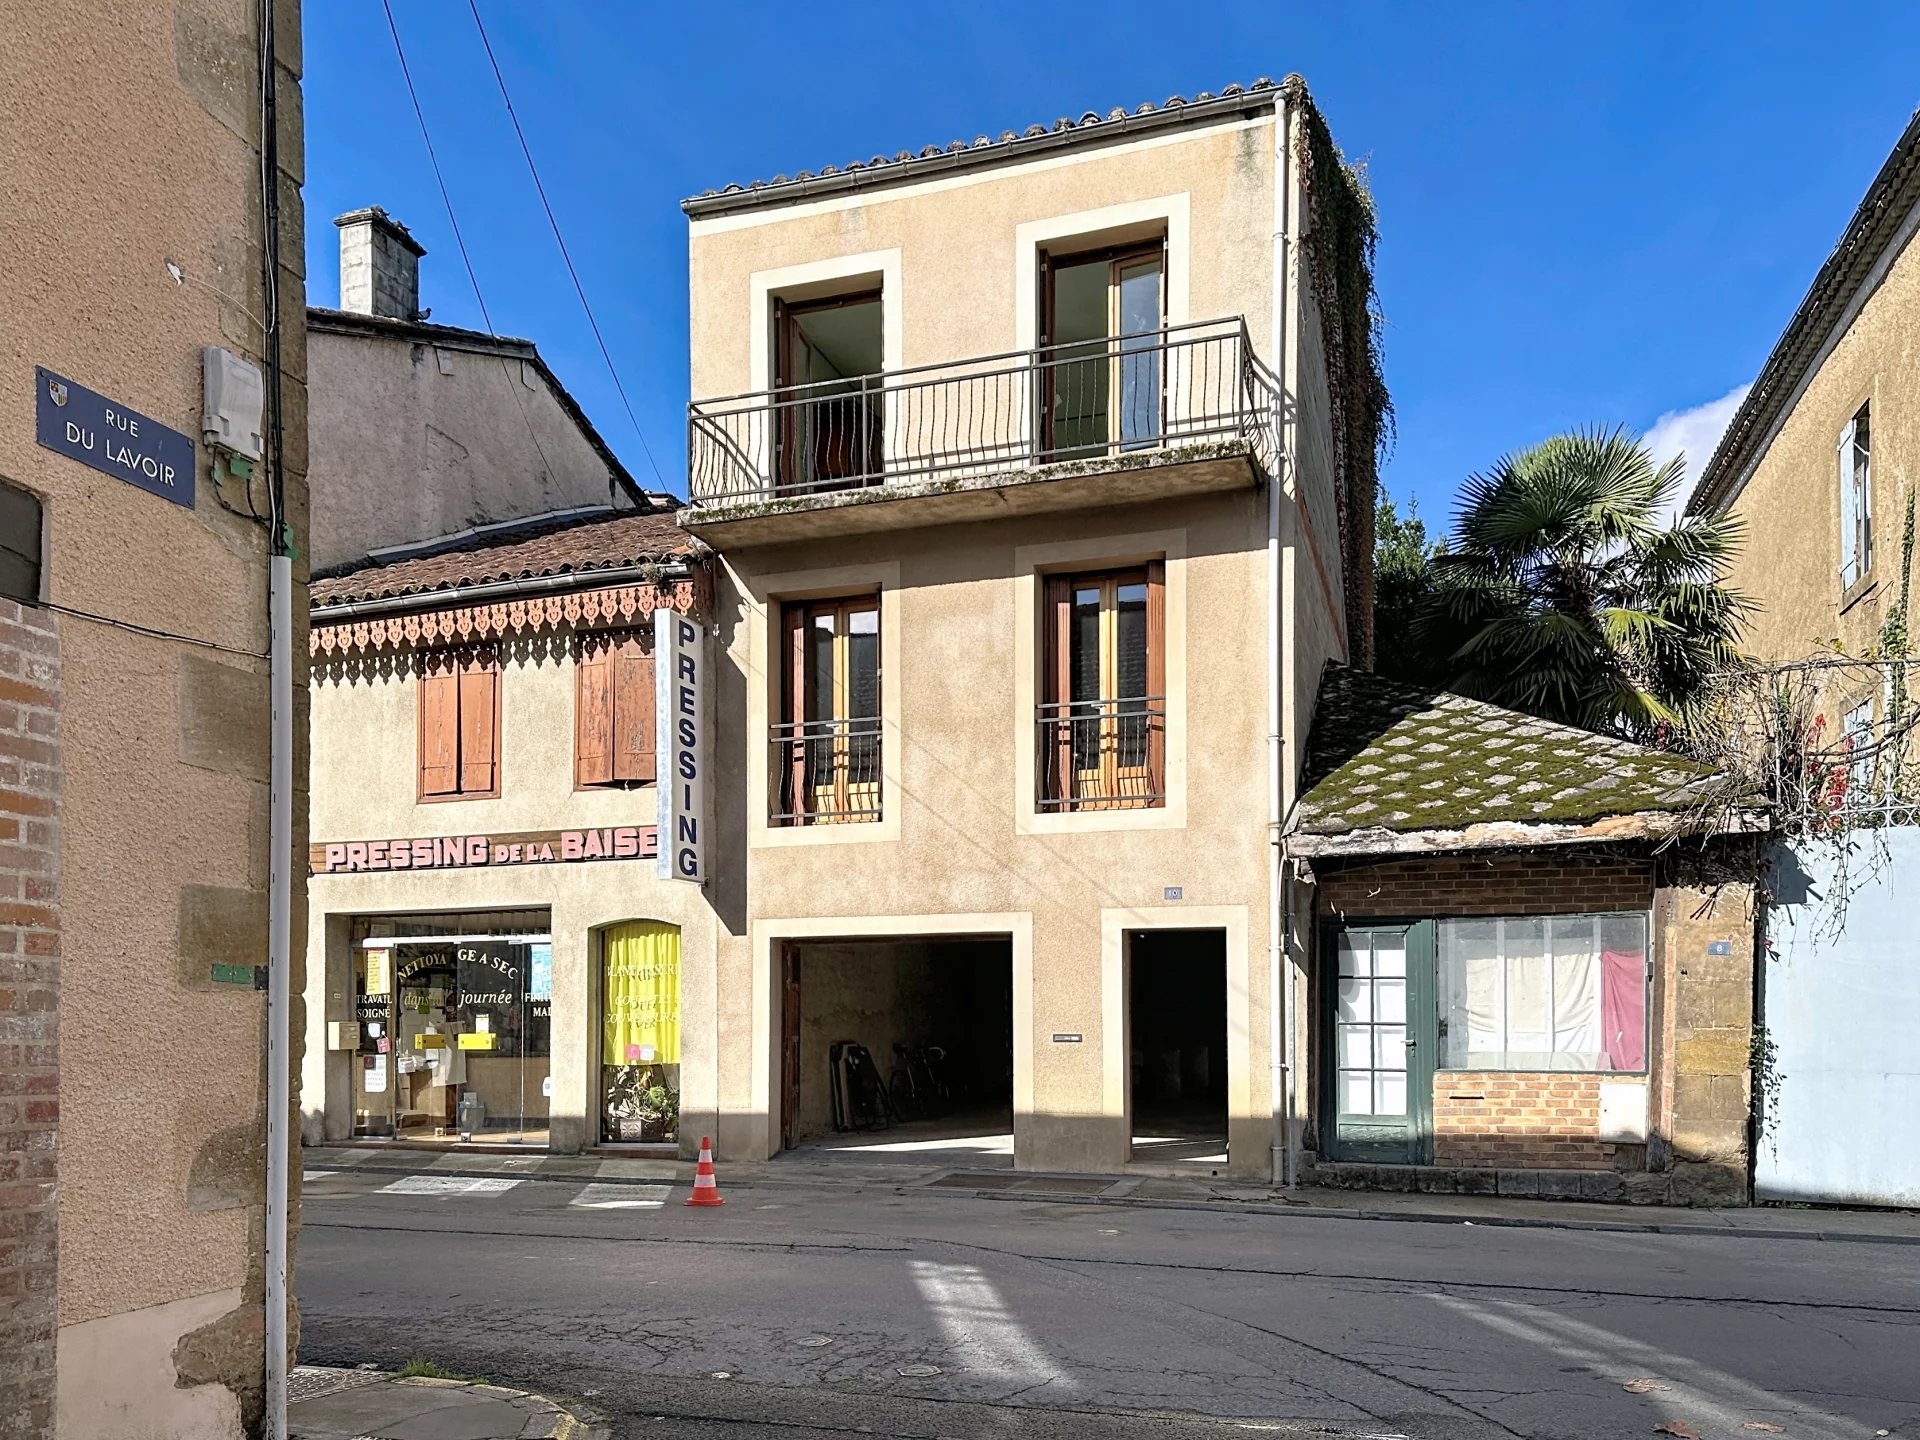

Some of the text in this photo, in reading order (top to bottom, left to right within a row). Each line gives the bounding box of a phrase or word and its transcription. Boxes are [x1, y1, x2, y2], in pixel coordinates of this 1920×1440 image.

[106, 408, 139, 438] RUE
[66, 421, 175, 487] DU LAVOIR
[678, 619, 698, 877] PRESSING
[325, 835, 489, 873] PRESSING
[495, 844, 522, 864] DE
[526, 842, 554, 862] LA
[490, 957, 519, 980] SEC
[356, 994, 393, 1004] TRAVAIL
[457, 989, 513, 1008] journée
[357, 1006, 391, 1018] SOIGNÉ
